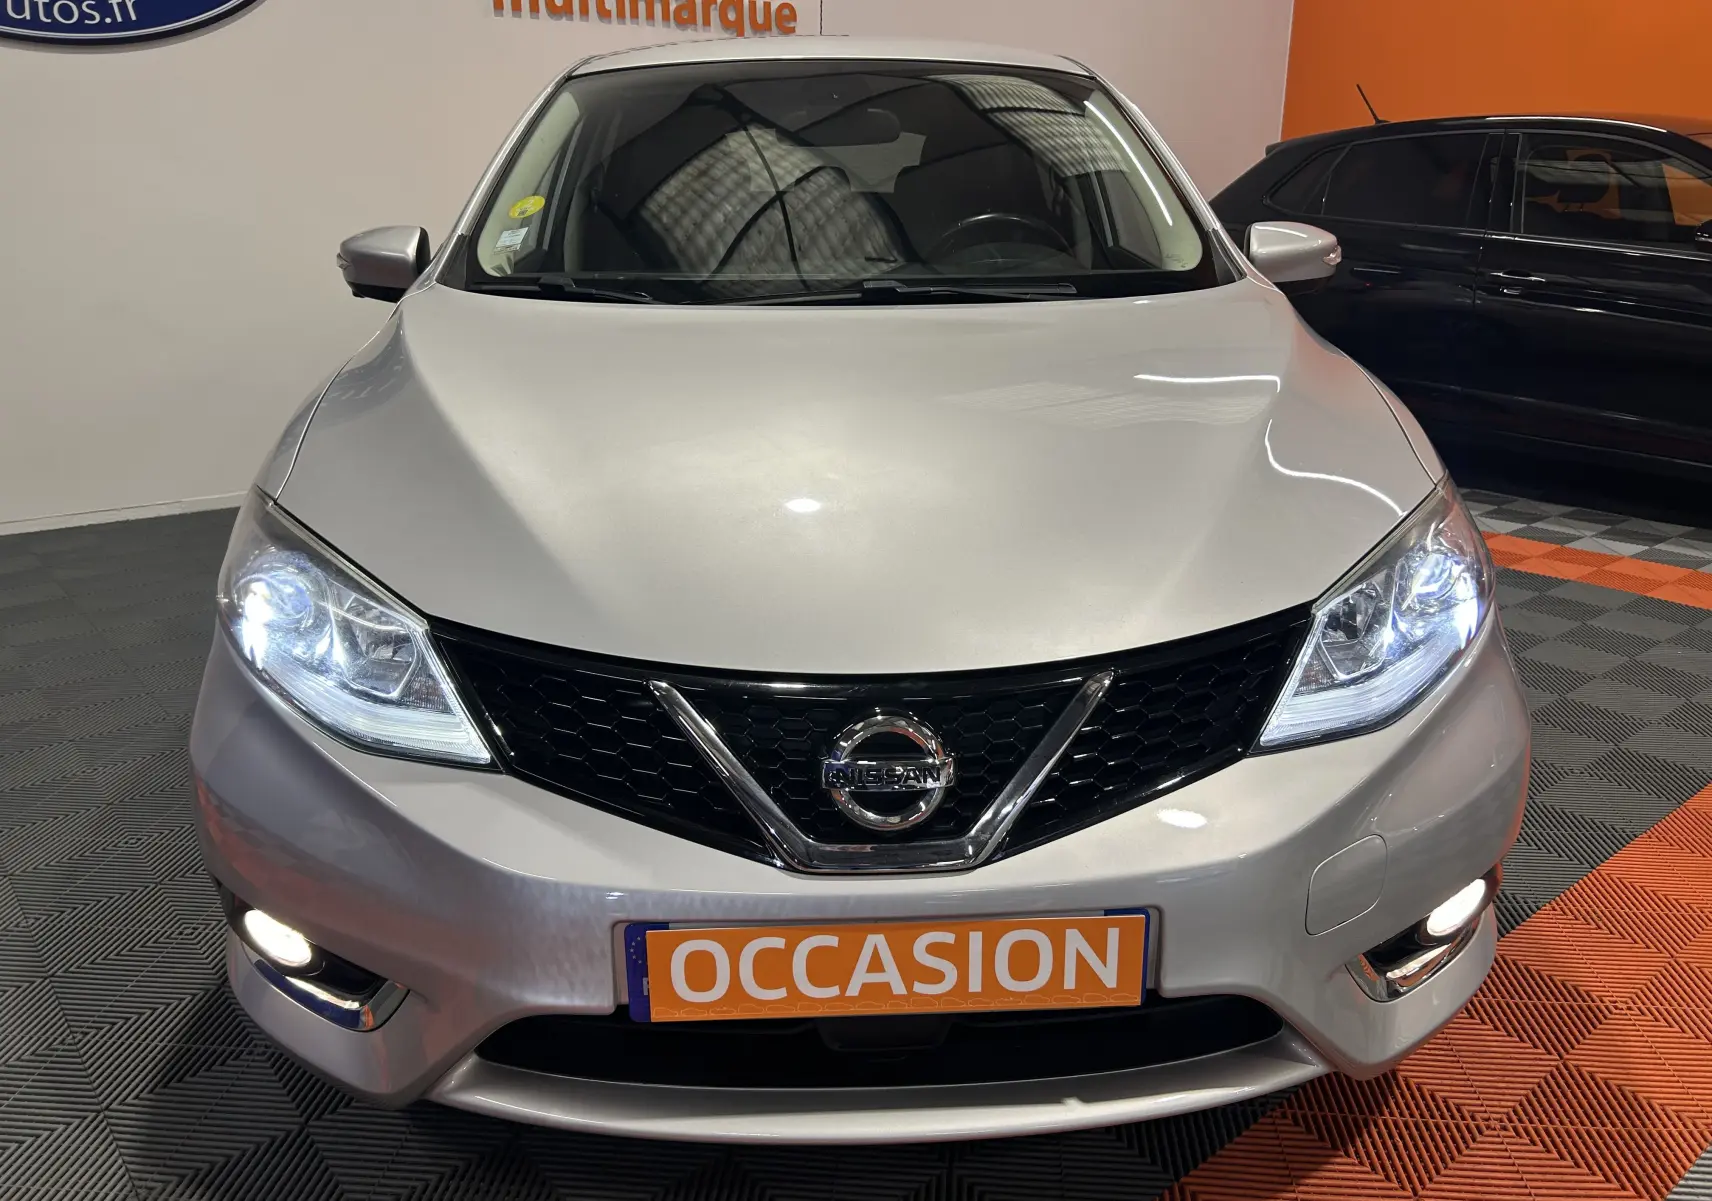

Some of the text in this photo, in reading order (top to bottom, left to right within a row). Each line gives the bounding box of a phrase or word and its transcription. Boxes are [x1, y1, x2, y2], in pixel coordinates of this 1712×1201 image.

[493, 0, 797, 37] marque
[830, 766, 941, 786] NISSAN
[670, 927, 1120, 1003] OCCASION
